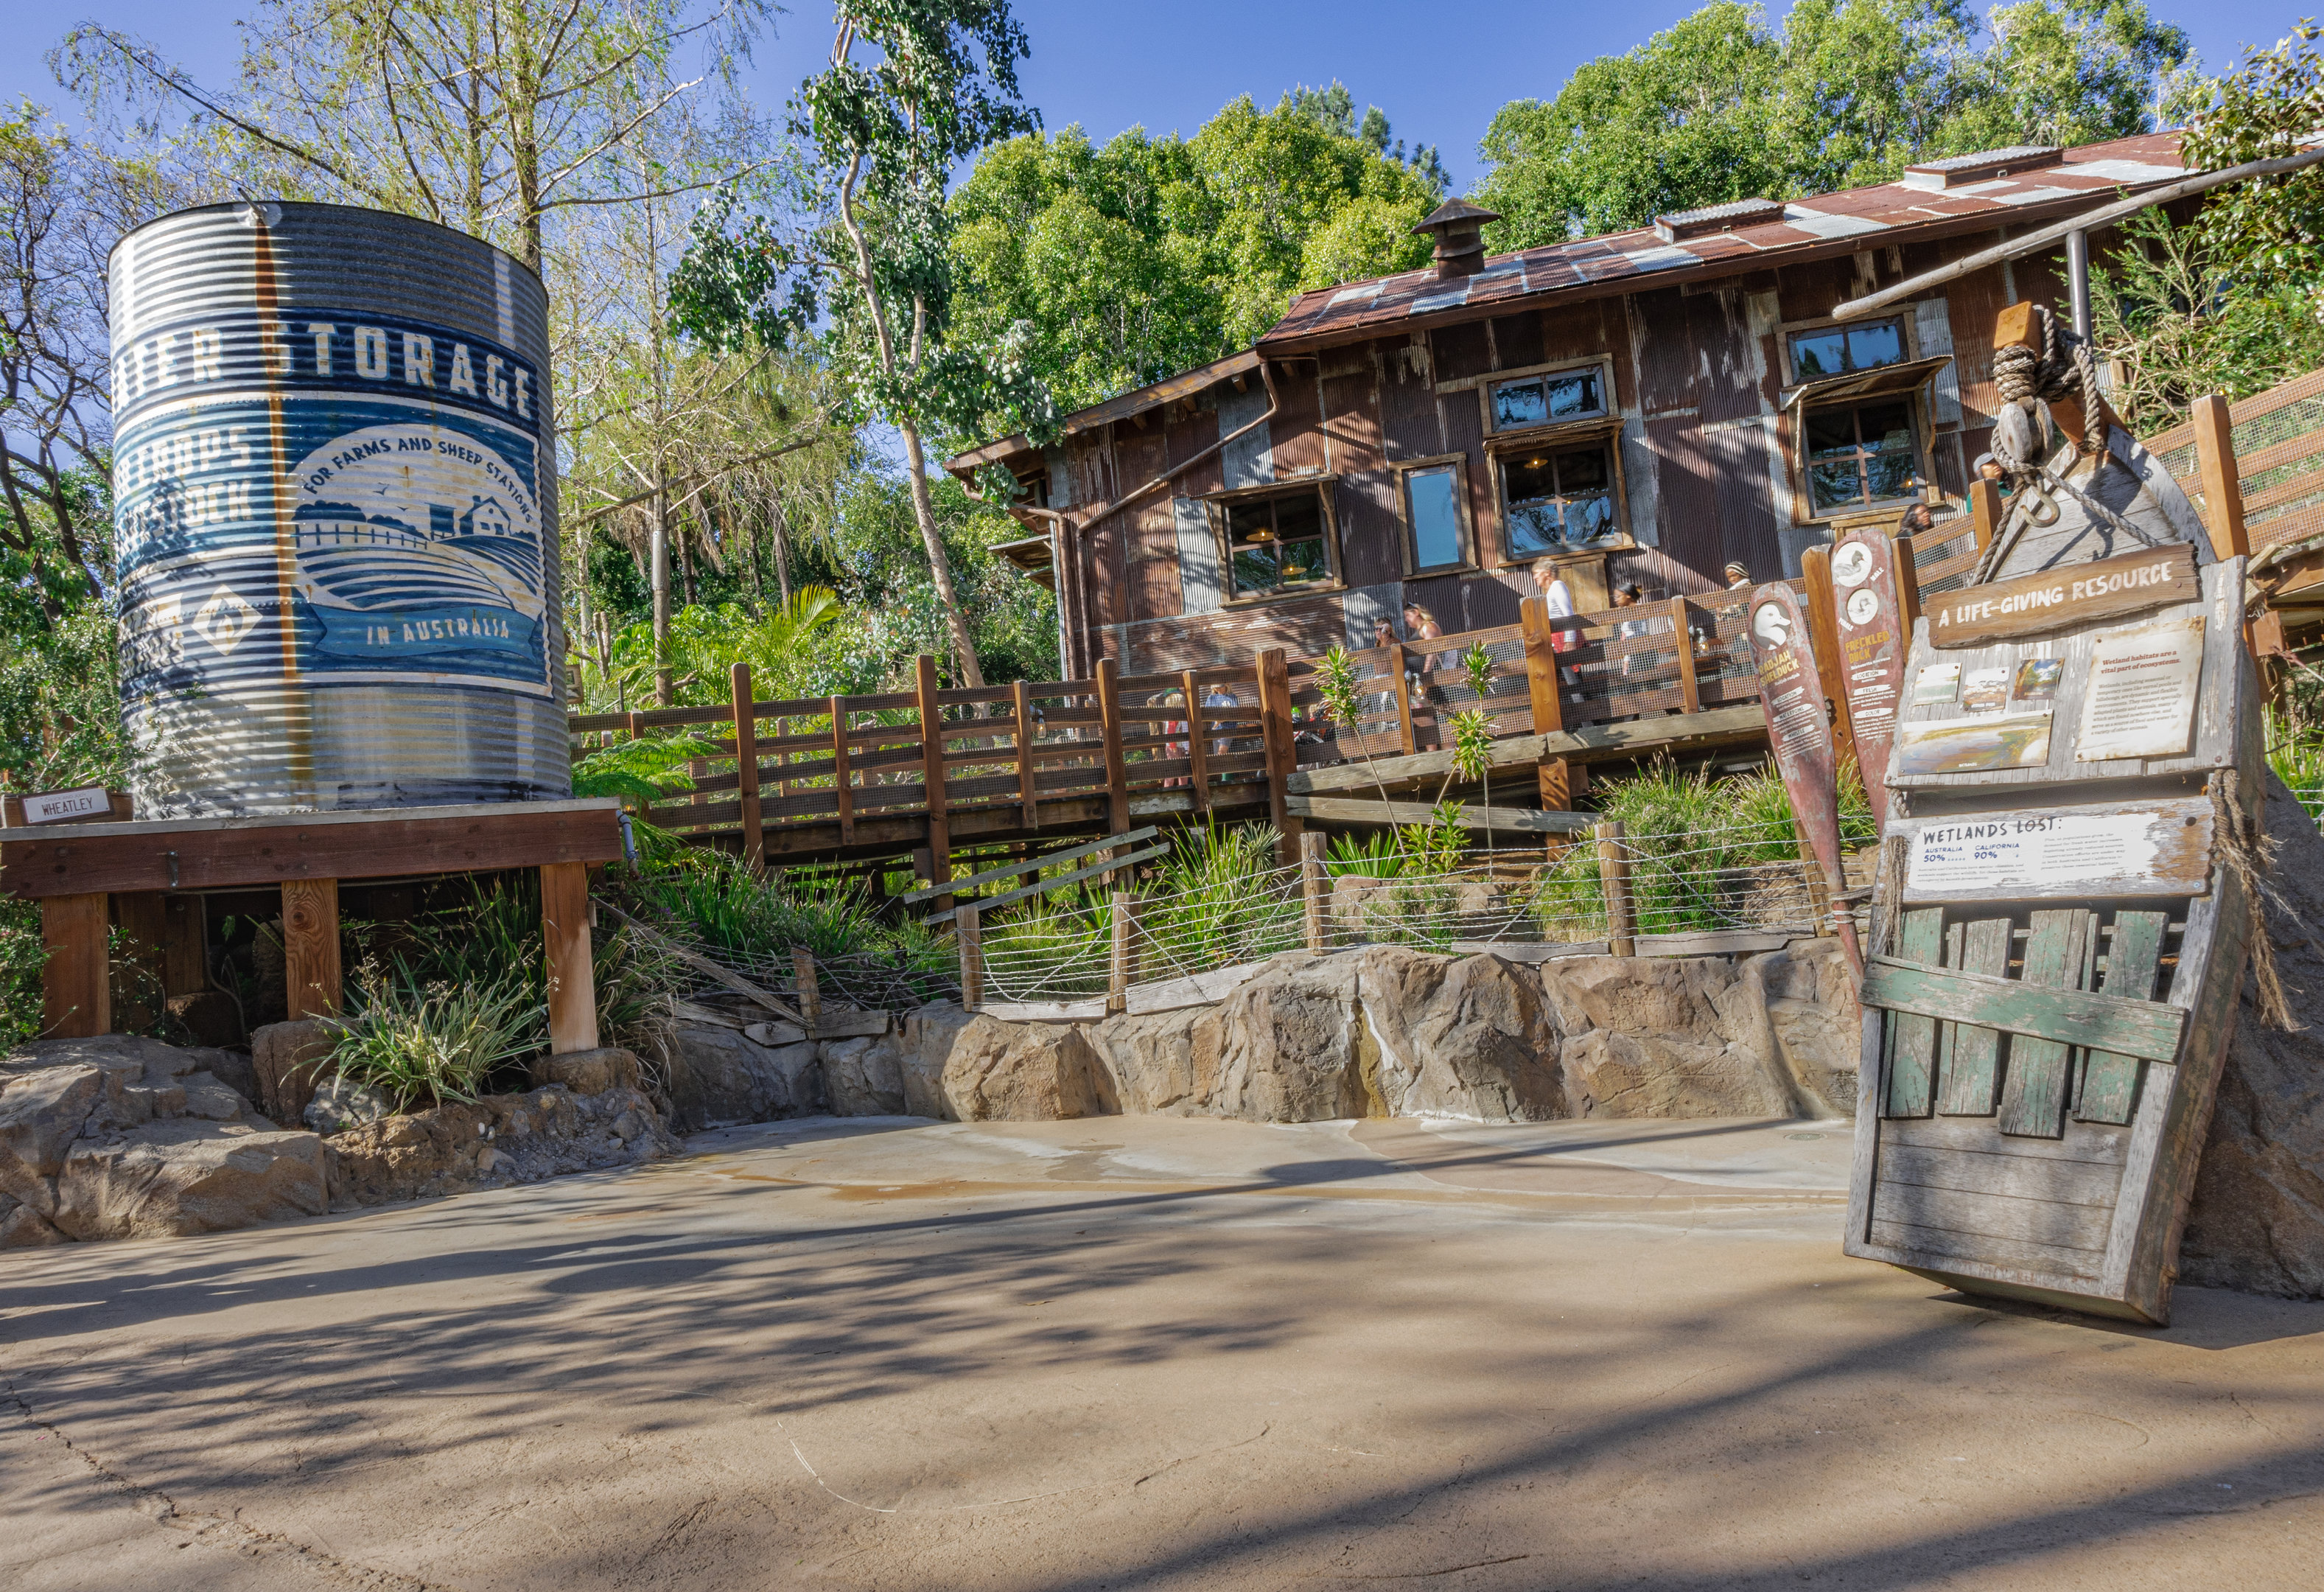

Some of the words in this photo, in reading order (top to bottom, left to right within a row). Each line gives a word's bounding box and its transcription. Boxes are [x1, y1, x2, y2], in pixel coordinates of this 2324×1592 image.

[111, 329, 223, 419] ATER
[262, 322, 532, 421] STORAGE
[303, 467, 335, 495] FOR
[332, 439, 391, 470] FARMS
[398, 438, 433, 451] AND
[439, 441, 483, 465] SHEEP
[486, 461, 533, 523] STATIONS
[1870, 567, 1884, 582] MALE
[1939, 610, 1950, 628] A
[1957, 587, 2063, 624] LIFE-GIVING
[2072, 561, 2173, 601] RESOURCE
[366, 626, 390, 645] IN
[403, 618, 509, 643] AUSTRALIA
[1845, 630, 1890, 653] FRECKLED
[1758, 650, 1791, 675] RADJAH
[1848, 648, 1871, 663] DUCK
[2103, 656, 2130, 665] Wetland
[2140, 659, 2181, 668] ecosystems.
[1760, 658, 1799, 687] SHELDUCK
[1857, 671, 1879, 679] LOCATION
[1777, 691, 1797, 702] LOCATION
[1779, 706, 1804, 719] WATERFOWL
[1788, 728, 1805, 739] WHISTLE
[42, 797, 93, 816] WHEATLEY
[1924, 823, 2007, 845] WETLANDS
[2017, 816, 2062, 834] LOST:
[1975, 842, 2020, 851] CALIFORNIA
[1923, 854, 1945, 862] 50%
[1974, 851, 1998, 859] 90%
